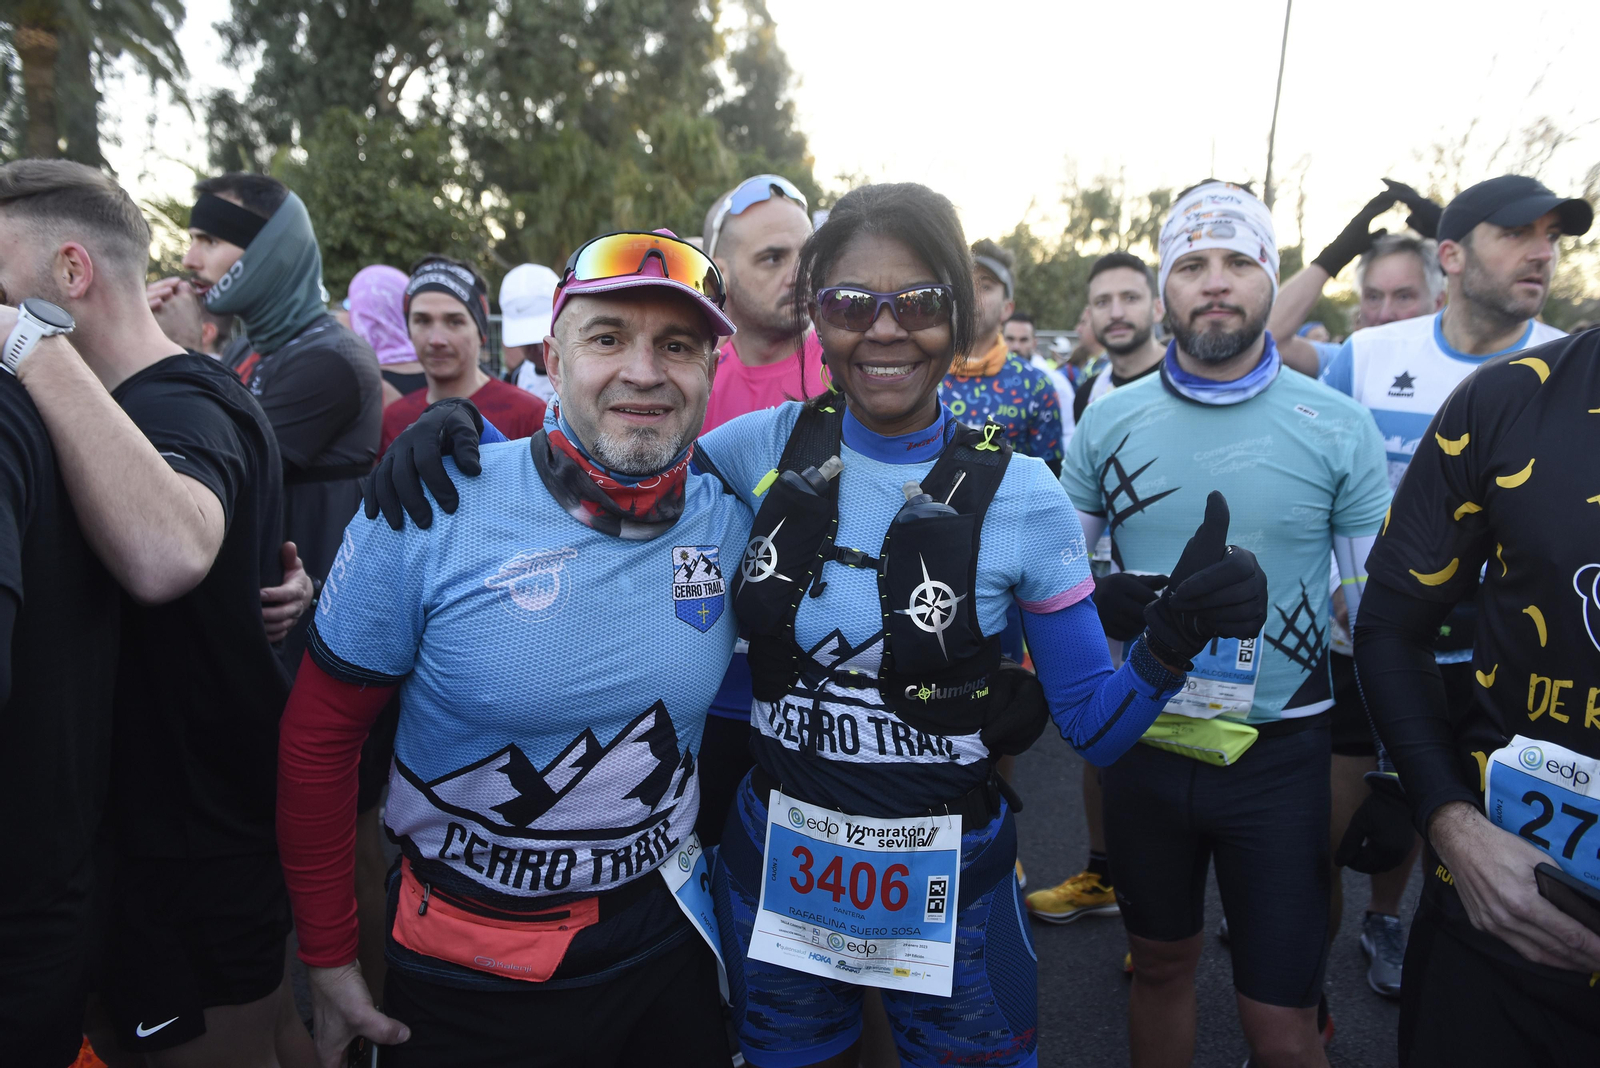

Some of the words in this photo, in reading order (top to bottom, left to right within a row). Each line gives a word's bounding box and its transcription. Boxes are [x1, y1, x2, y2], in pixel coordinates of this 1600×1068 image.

[674, 584, 703, 599] CERRO
[703, 580, 724, 596] TRAIL
[1200, 668, 1255, 679] ALCOBENDAS
[904, 676, 986, 700] Columbus
[975, 686, 989, 699] Trail
[1527, 672, 1574, 724] DE
[867, 716, 961, 760] TRAIL
[1545, 760, 1590, 787] edp
[806, 816, 840, 838] edp
[862, 825, 926, 838] maratón
[877, 835, 926, 848] sevilla
[439, 821, 578, 891] CERRO
[590, 818, 681, 886] TRAIL
[789, 845, 910, 912] 3406
[788, 906, 847, 931] RAFAELINA
[849, 925, 888, 936] SUERO
[891, 927, 921, 936] SOSA
[833, 906, 866, 920] PANTERA
[808, 952, 832, 965] HOKA
[847, 940, 877, 958] edp
[496, 961, 533, 973] Kalenji
